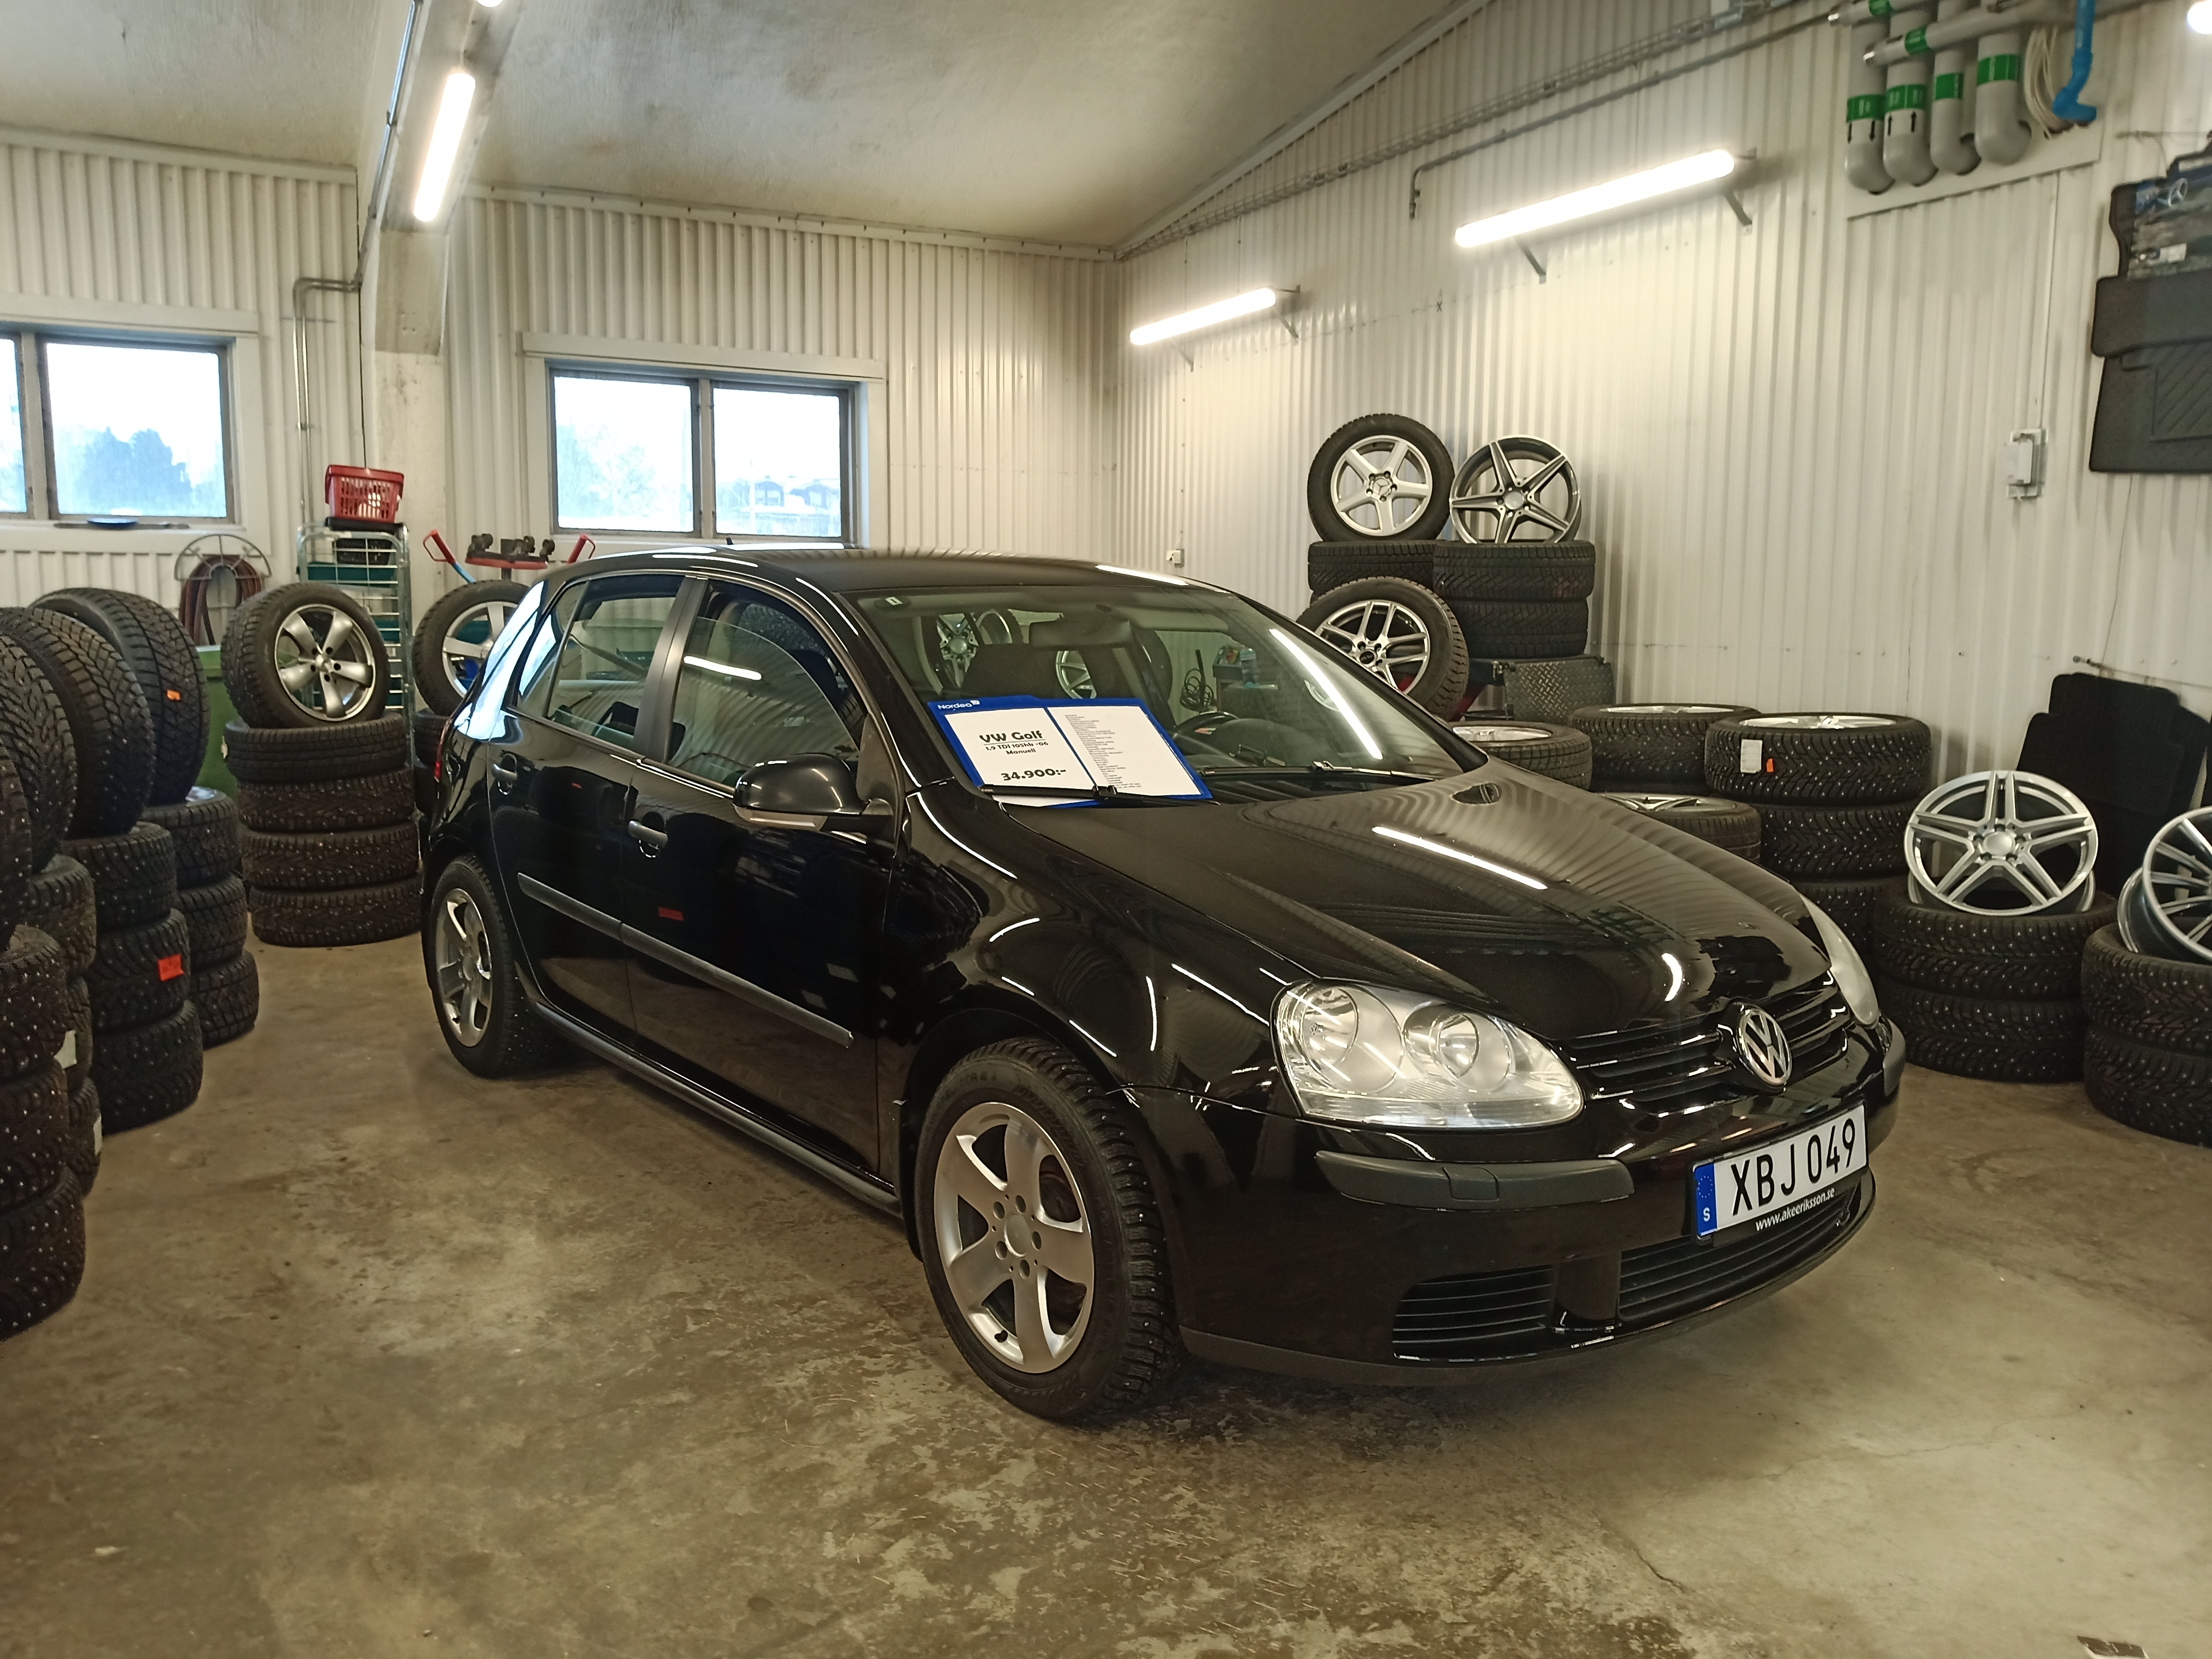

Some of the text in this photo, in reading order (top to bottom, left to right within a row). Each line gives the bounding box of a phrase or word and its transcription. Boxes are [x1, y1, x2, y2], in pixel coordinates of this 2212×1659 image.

[979, 730, 1044, 743] VW Golf
[1001, 768, 1067, 781] 34.900:-
[1730, 1118, 1856, 1216] XBJ 049
[1703, 1207, 1711, 1222] S
[1755, 1187, 1835, 1231] www.akeeriksson.se
